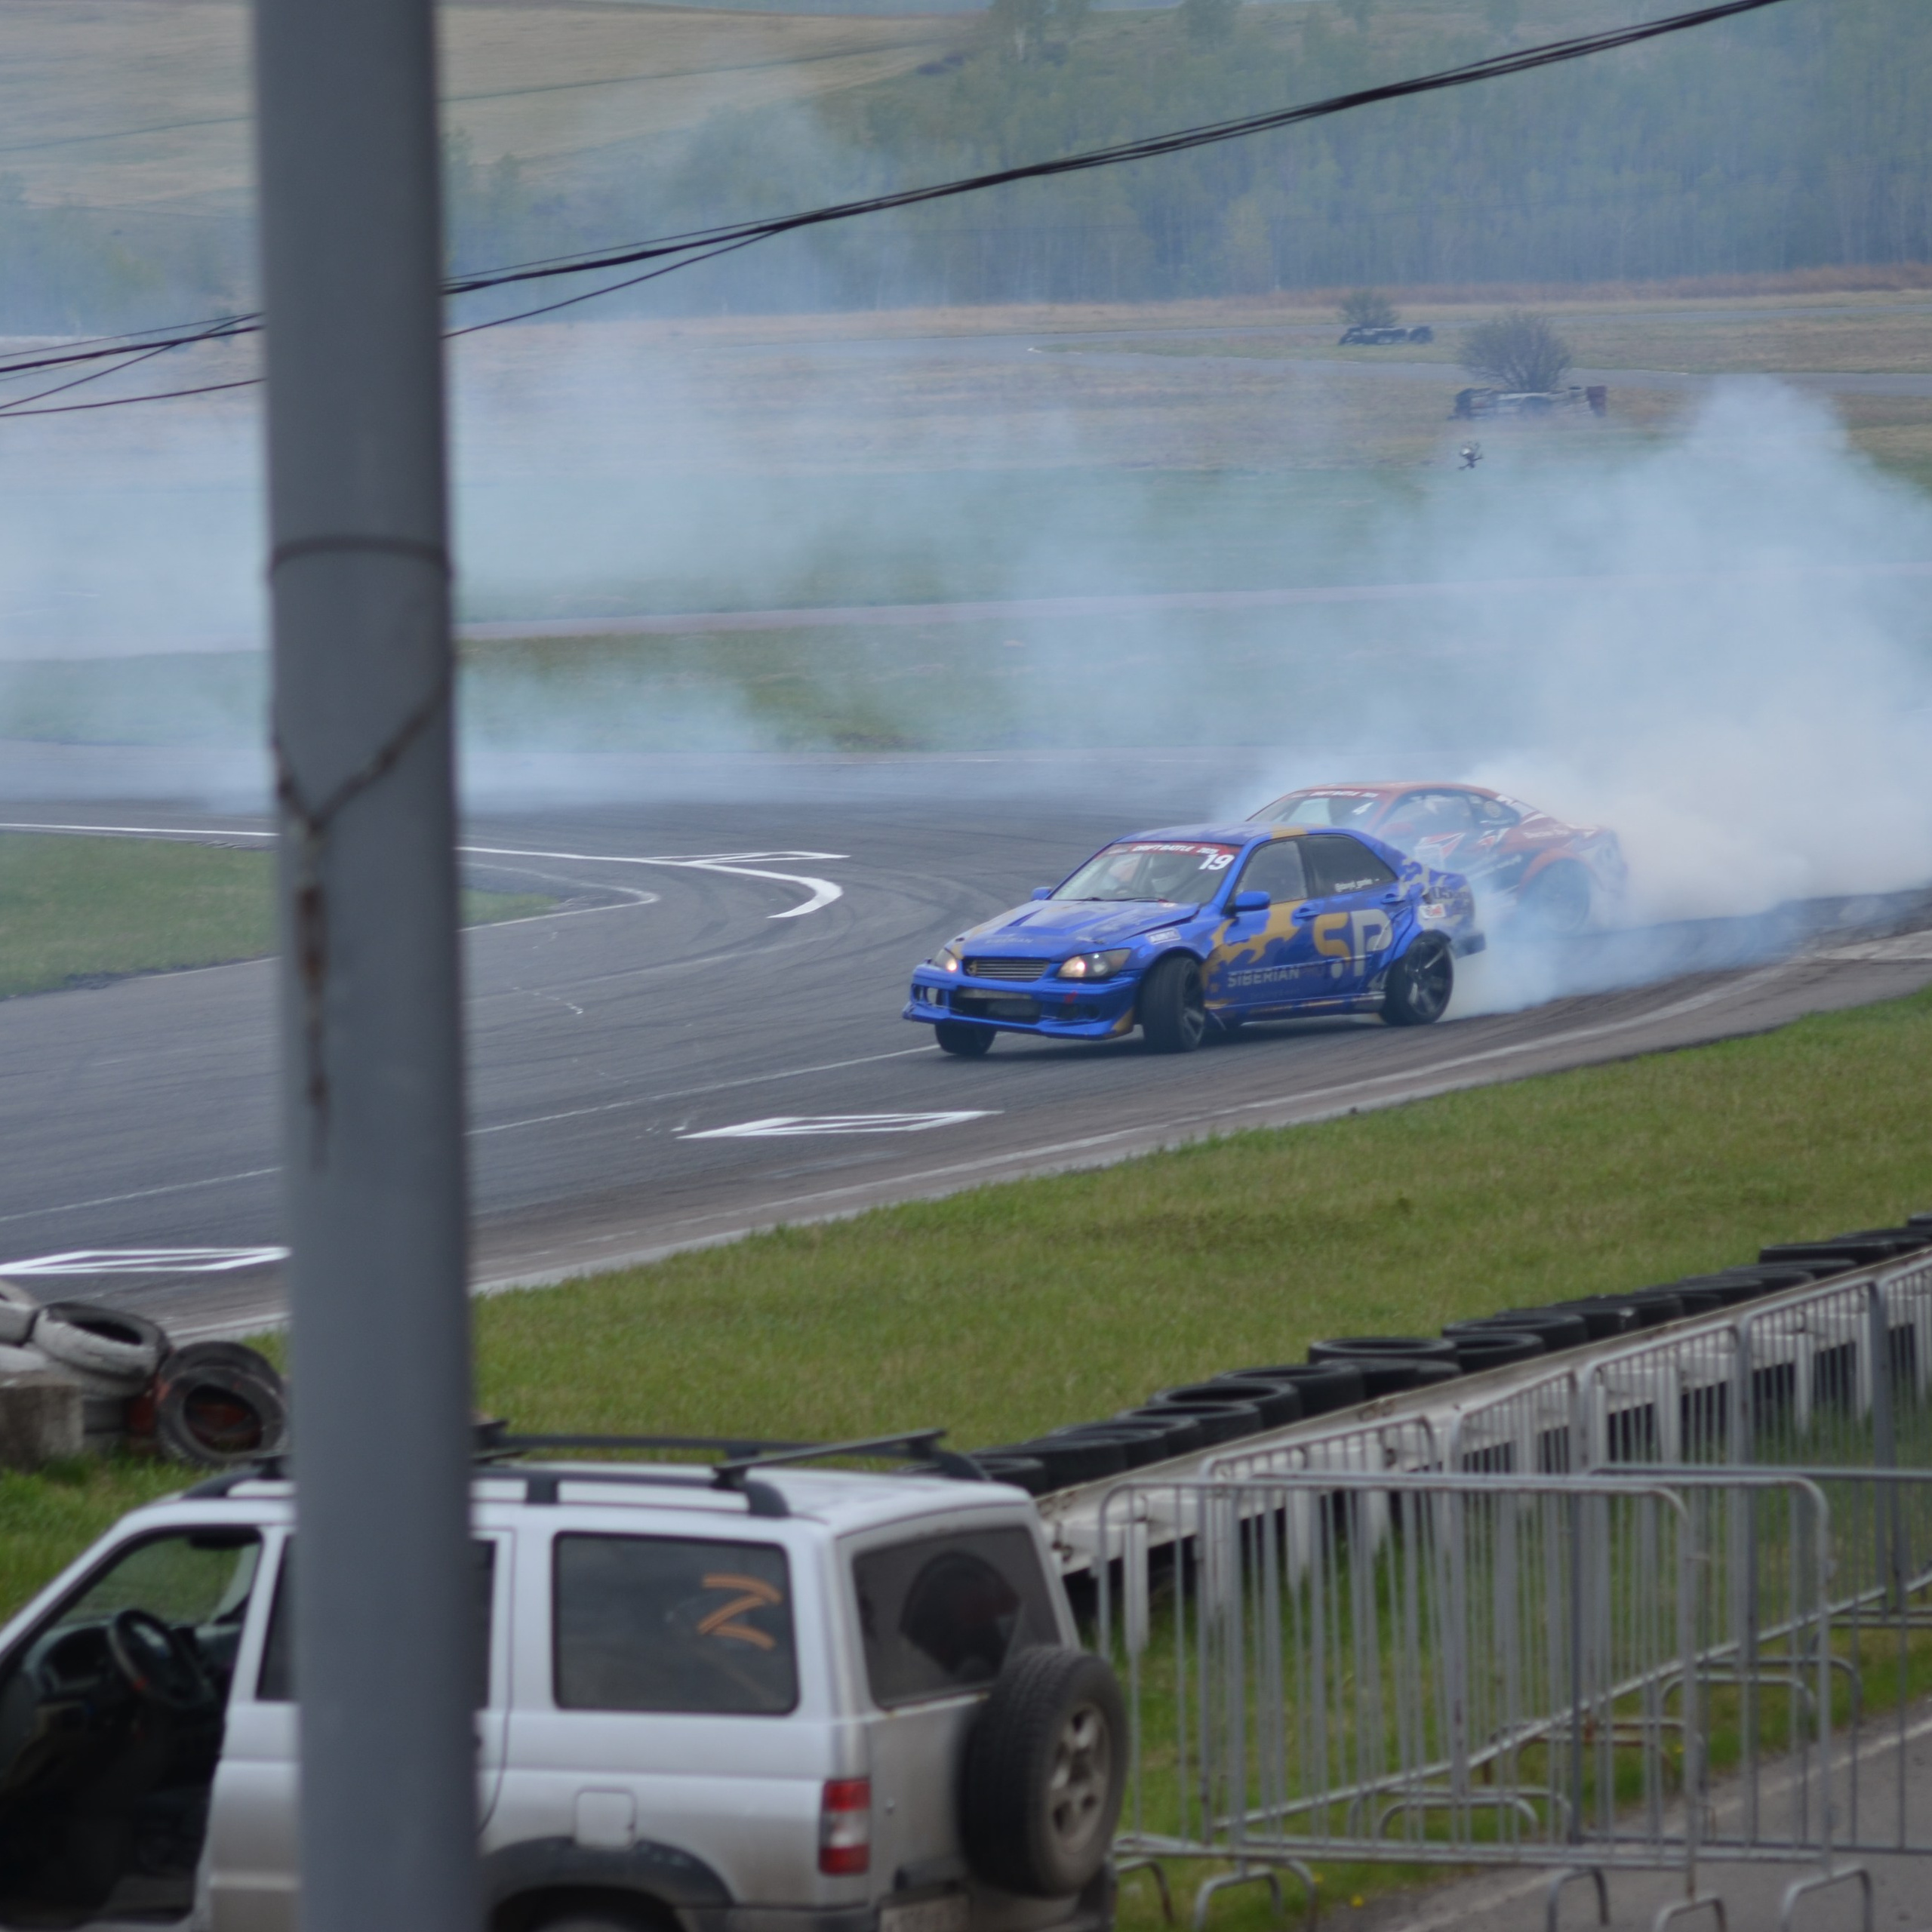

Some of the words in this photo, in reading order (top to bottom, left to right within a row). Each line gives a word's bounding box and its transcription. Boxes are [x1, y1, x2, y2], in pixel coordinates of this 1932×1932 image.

[1198, 854, 1235, 870] 19
[1312, 908, 1393, 980] SP
[1226, 966, 1300, 989] SIBERIAN
[697, 1572, 783, 1651] Z
